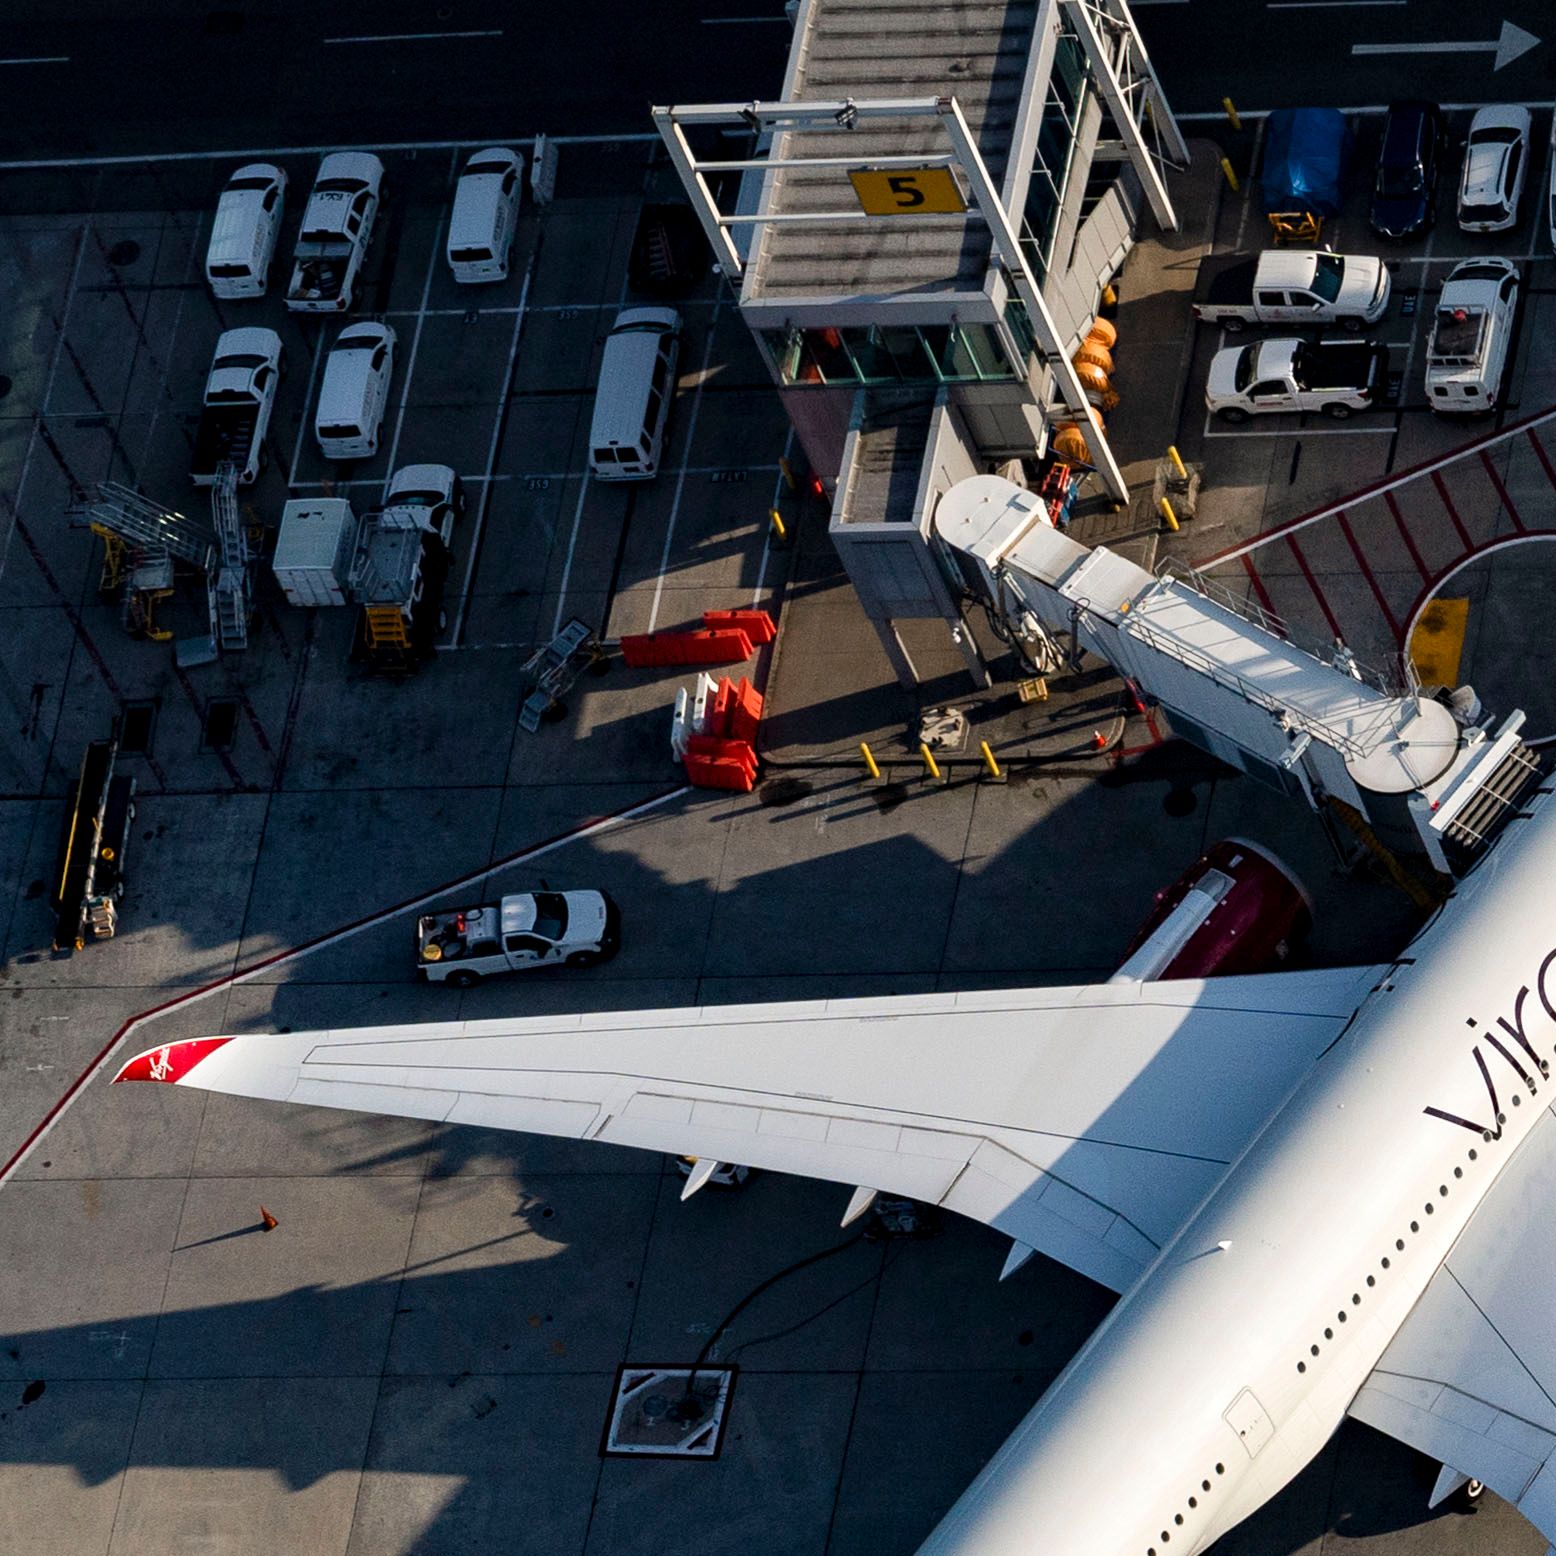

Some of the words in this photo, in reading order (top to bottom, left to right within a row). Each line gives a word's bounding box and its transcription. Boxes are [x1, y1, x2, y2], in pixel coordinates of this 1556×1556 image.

[888, 176, 924, 207] 5
[1402, 295, 1416, 313] UAE
[529, 479, 550, 490] GSE
[712, 471, 748, 482] LATAM
[149, 1047, 174, 1080] Virgin
